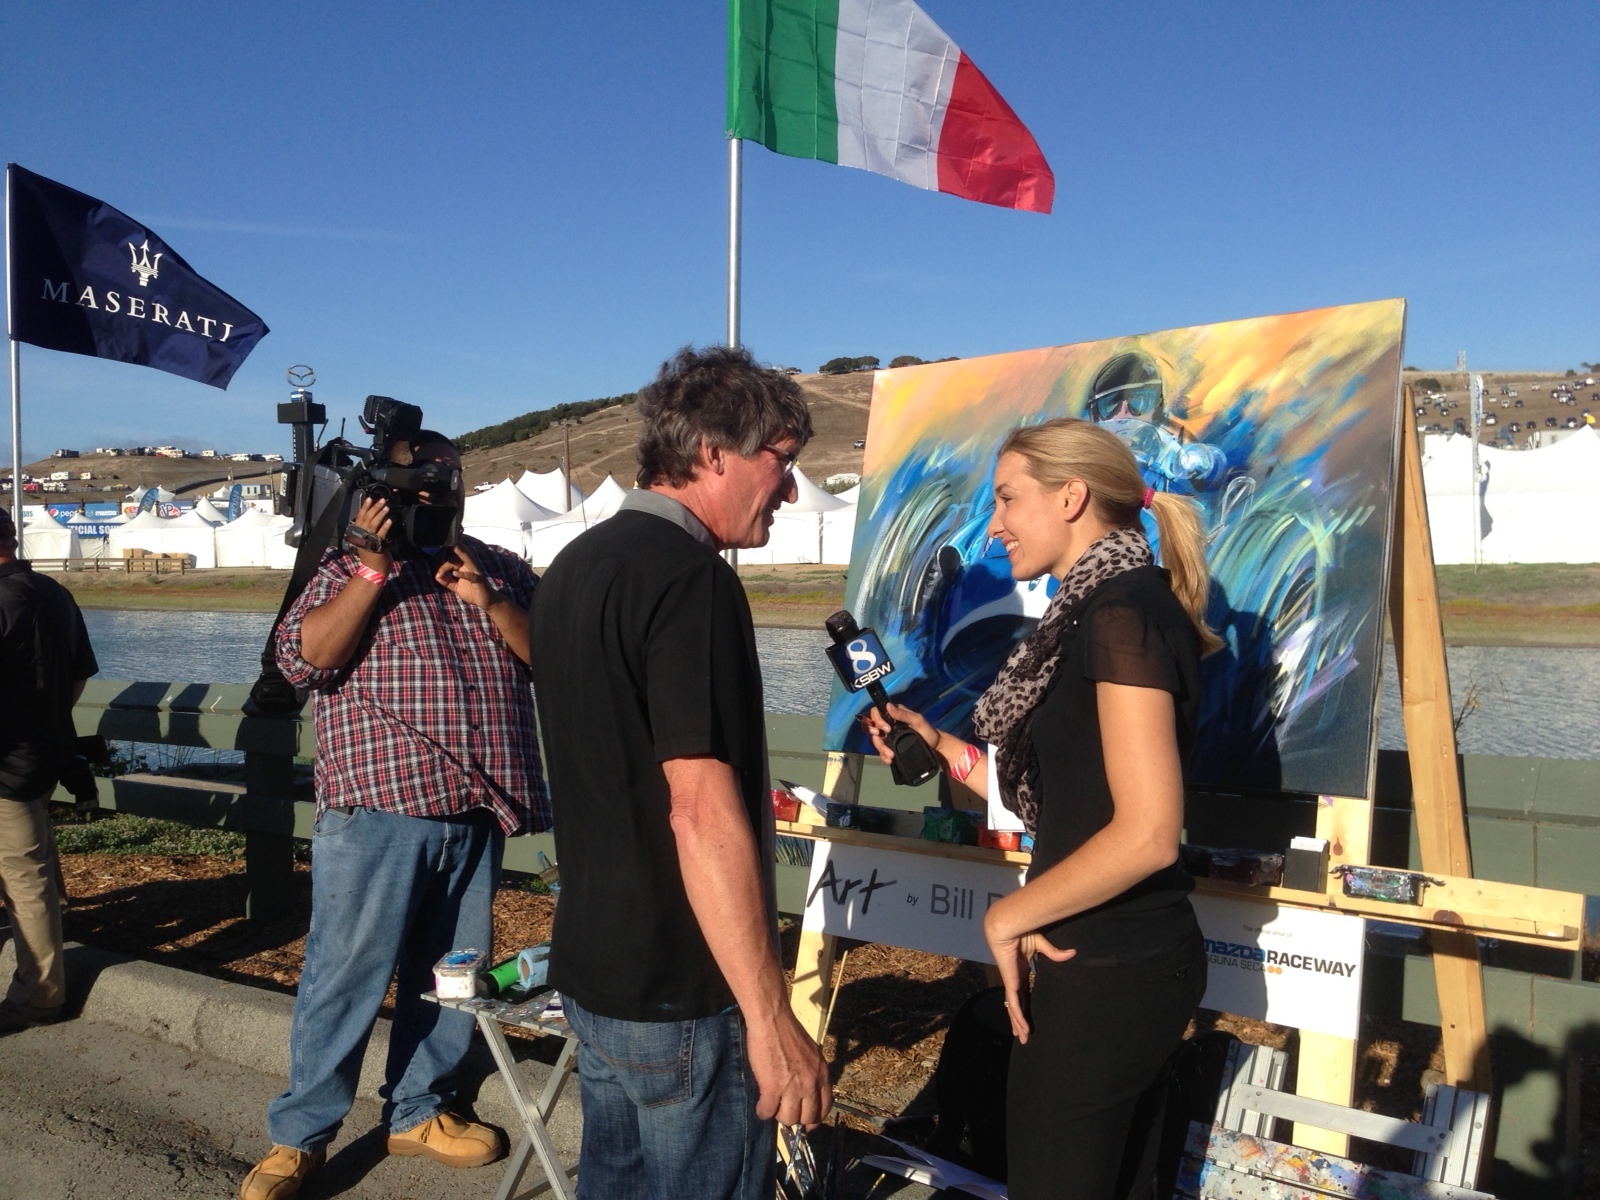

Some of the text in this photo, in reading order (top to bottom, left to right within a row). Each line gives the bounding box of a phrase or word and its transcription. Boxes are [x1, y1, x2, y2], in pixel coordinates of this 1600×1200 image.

[40, 278, 234, 342] MASERATI
[846, 639, 877, 674] 8
[851, 661, 891, 690] KSBW
[807, 858, 898, 915] Art
[906, 893, 919, 906] by
[930, 883, 973, 920] Bill
[1242, 924, 1253, 932] The
[1240, 959, 1267, 973] SECA
[1267, 950, 1357, 978] RACEWAY
